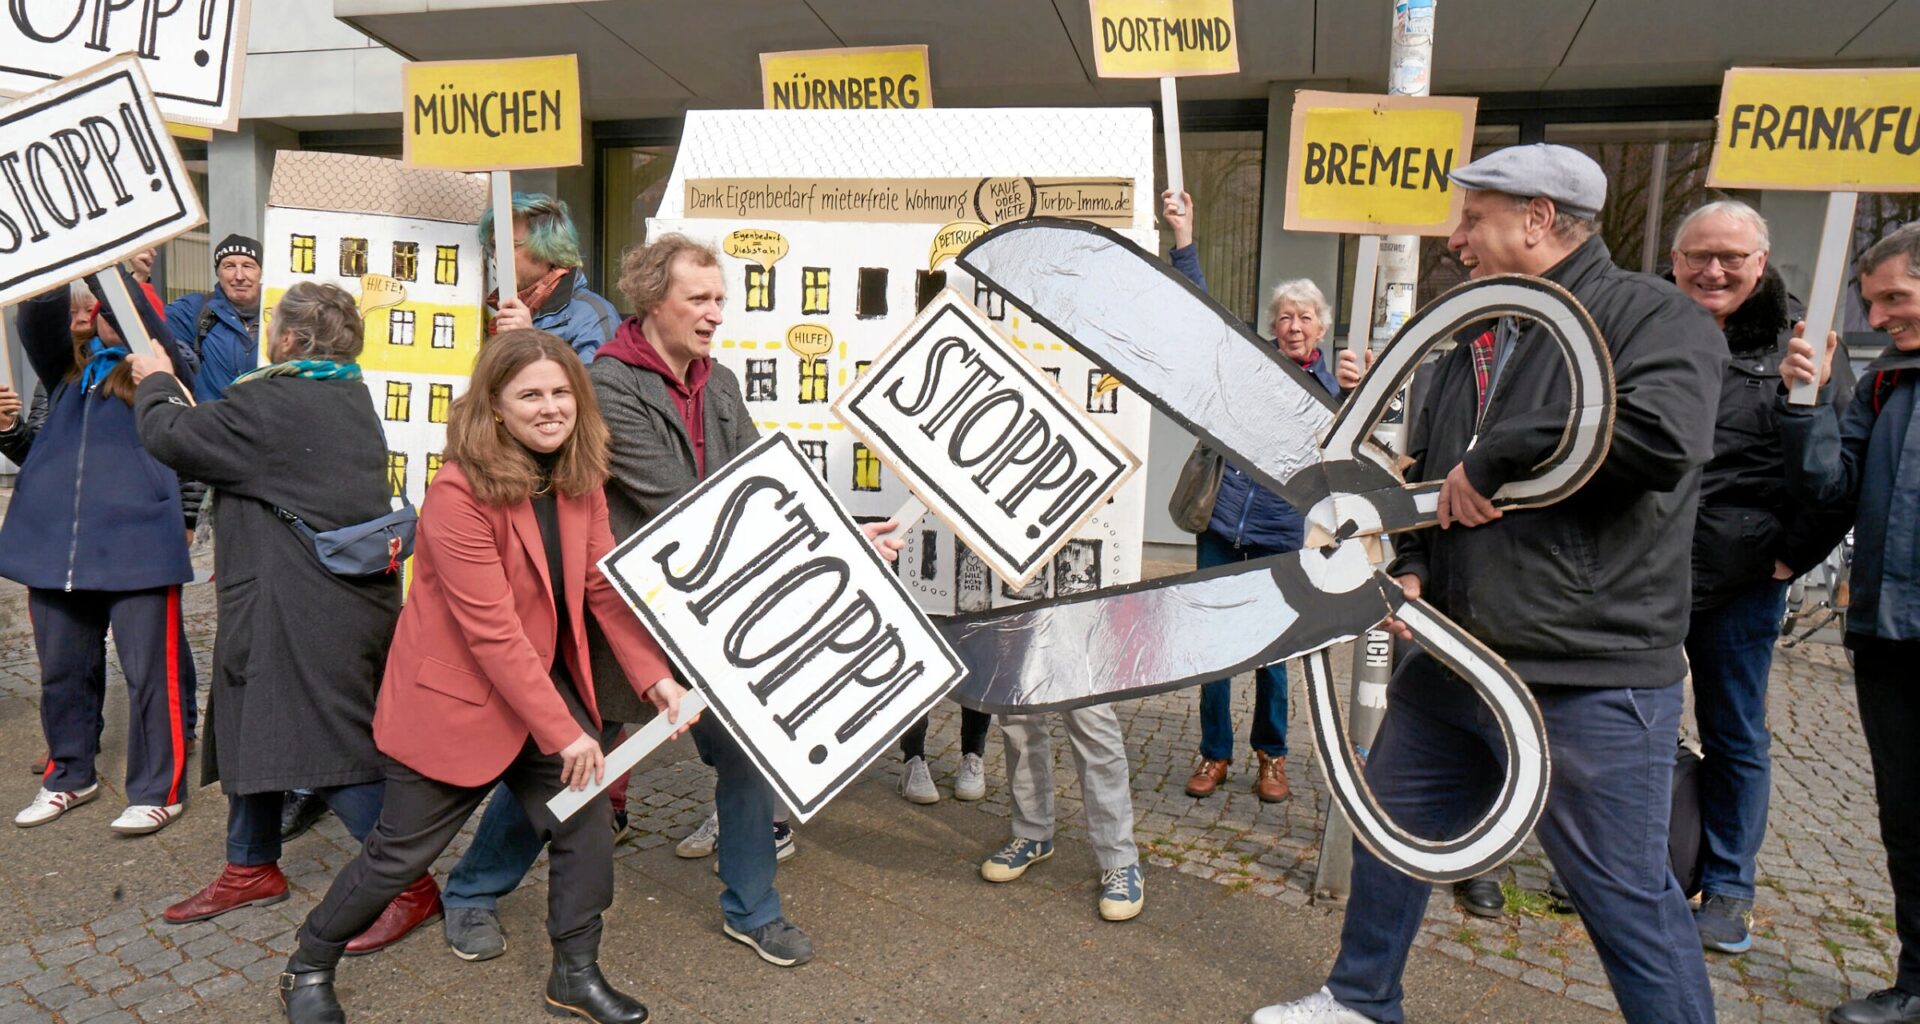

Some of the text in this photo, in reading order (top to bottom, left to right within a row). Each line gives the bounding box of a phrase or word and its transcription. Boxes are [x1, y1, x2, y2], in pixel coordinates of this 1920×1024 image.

[1102, 17, 1231, 53] DORTMUND
[773, 72, 920, 109] NÜRNBERG
[414, 84, 561, 138] MÜNCHEN
[1729, 103, 1920, 156] FRANKFU
[1304, 142, 1453, 193] BREMEN
[690, 183, 967, 219] Dank Eigenbedarf mieterfreie Wohnung
[989, 180, 1020, 198] KAUF
[995, 193, 1022, 207] ODER
[1039, 190, 1130, 212] Turbo-Immo.de
[994, 203, 1026, 223] MIETE
[367, 277, 403, 294] HILFE!
[794, 332, 828, 346] HILFE!
[883, 336, 1098, 540] STOPP!
[652, 475, 926, 765] STOPP!
[1366, 629, 1390, 668] ACH
